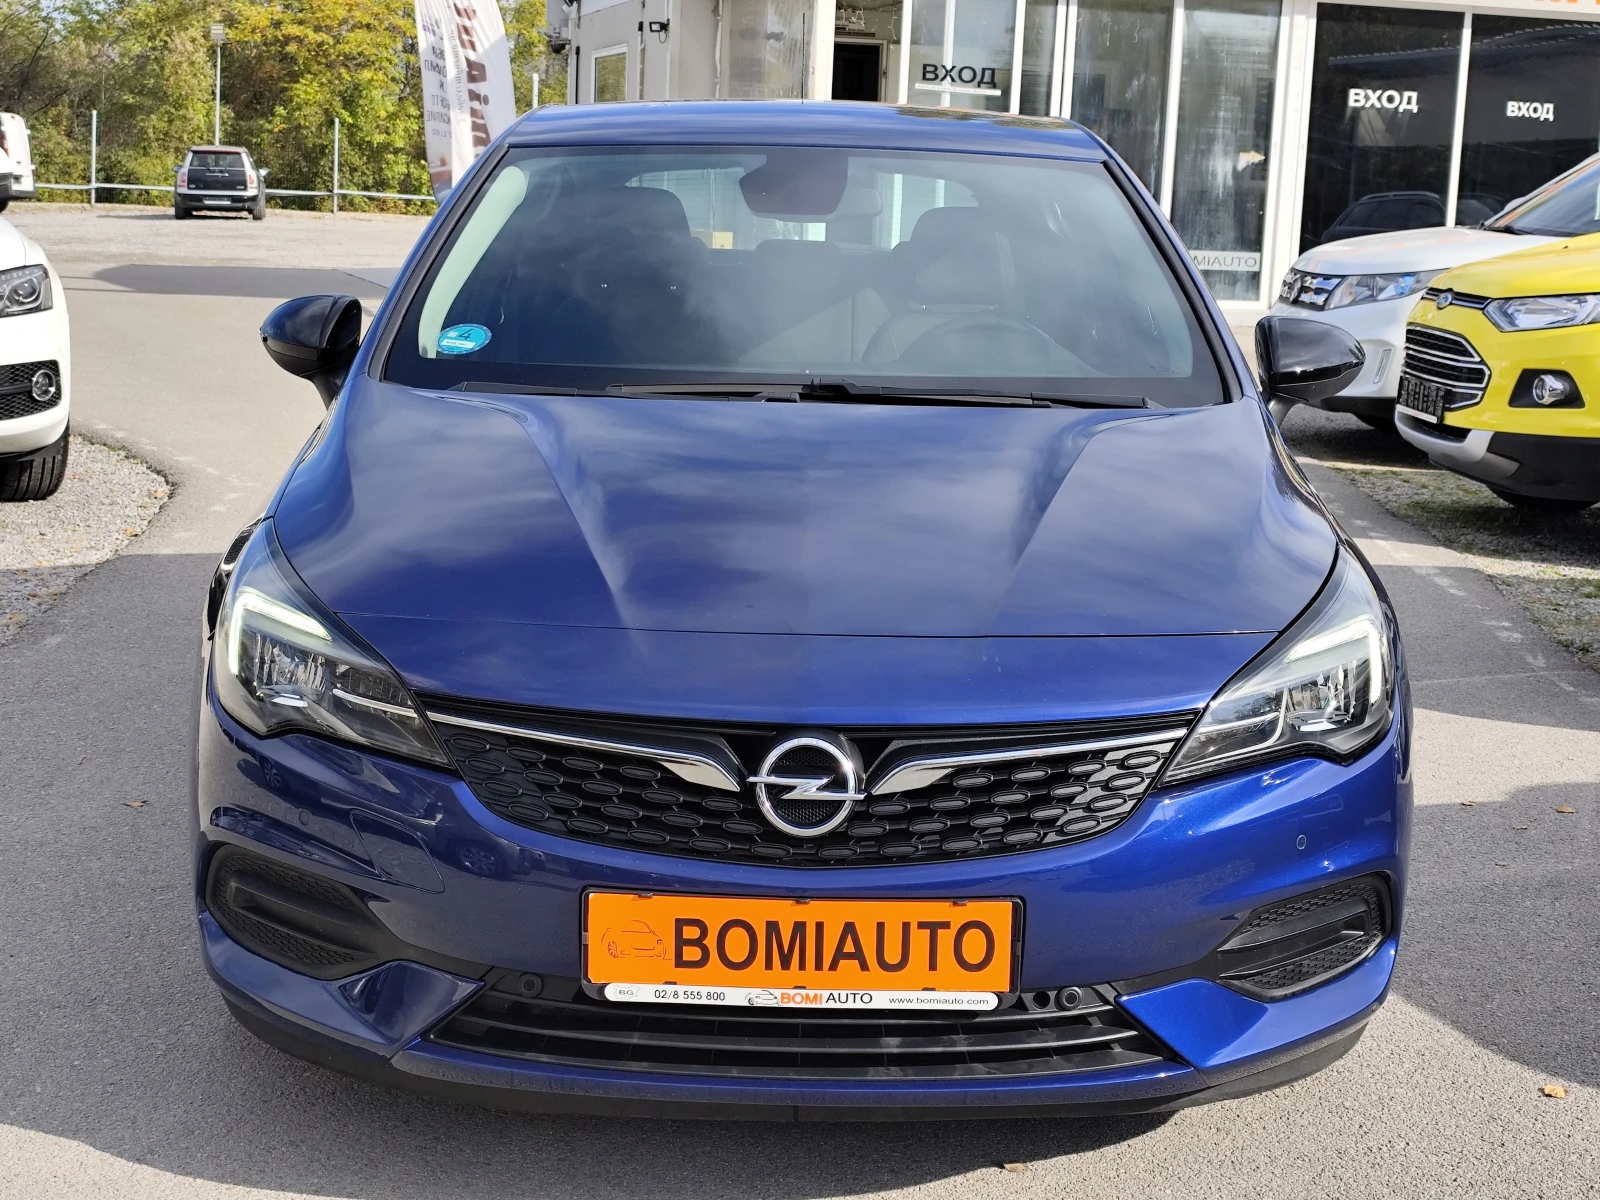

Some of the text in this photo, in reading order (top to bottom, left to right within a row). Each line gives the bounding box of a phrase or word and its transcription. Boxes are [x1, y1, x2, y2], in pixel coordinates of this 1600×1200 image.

[922, 63, 997, 88] ВХОД
[1348, 88, 1418, 113] ВХОД
[1506, 101, 1554, 121] ВХОД
[1193, 255, 1257, 268] MIAUTO
[458, 328, 474, 340] 4
[674, 917, 996, 973] BOMIAUTO
[654, 989, 679, 1001] 02/8
[683, 990, 703, 1001] 555
[705, 991, 726, 1001] 800
[780, 992, 823, 1005] BOMI
[825, 992, 873, 1004] AUTO
[888, 996, 989, 1006] www.bomiauto.com
